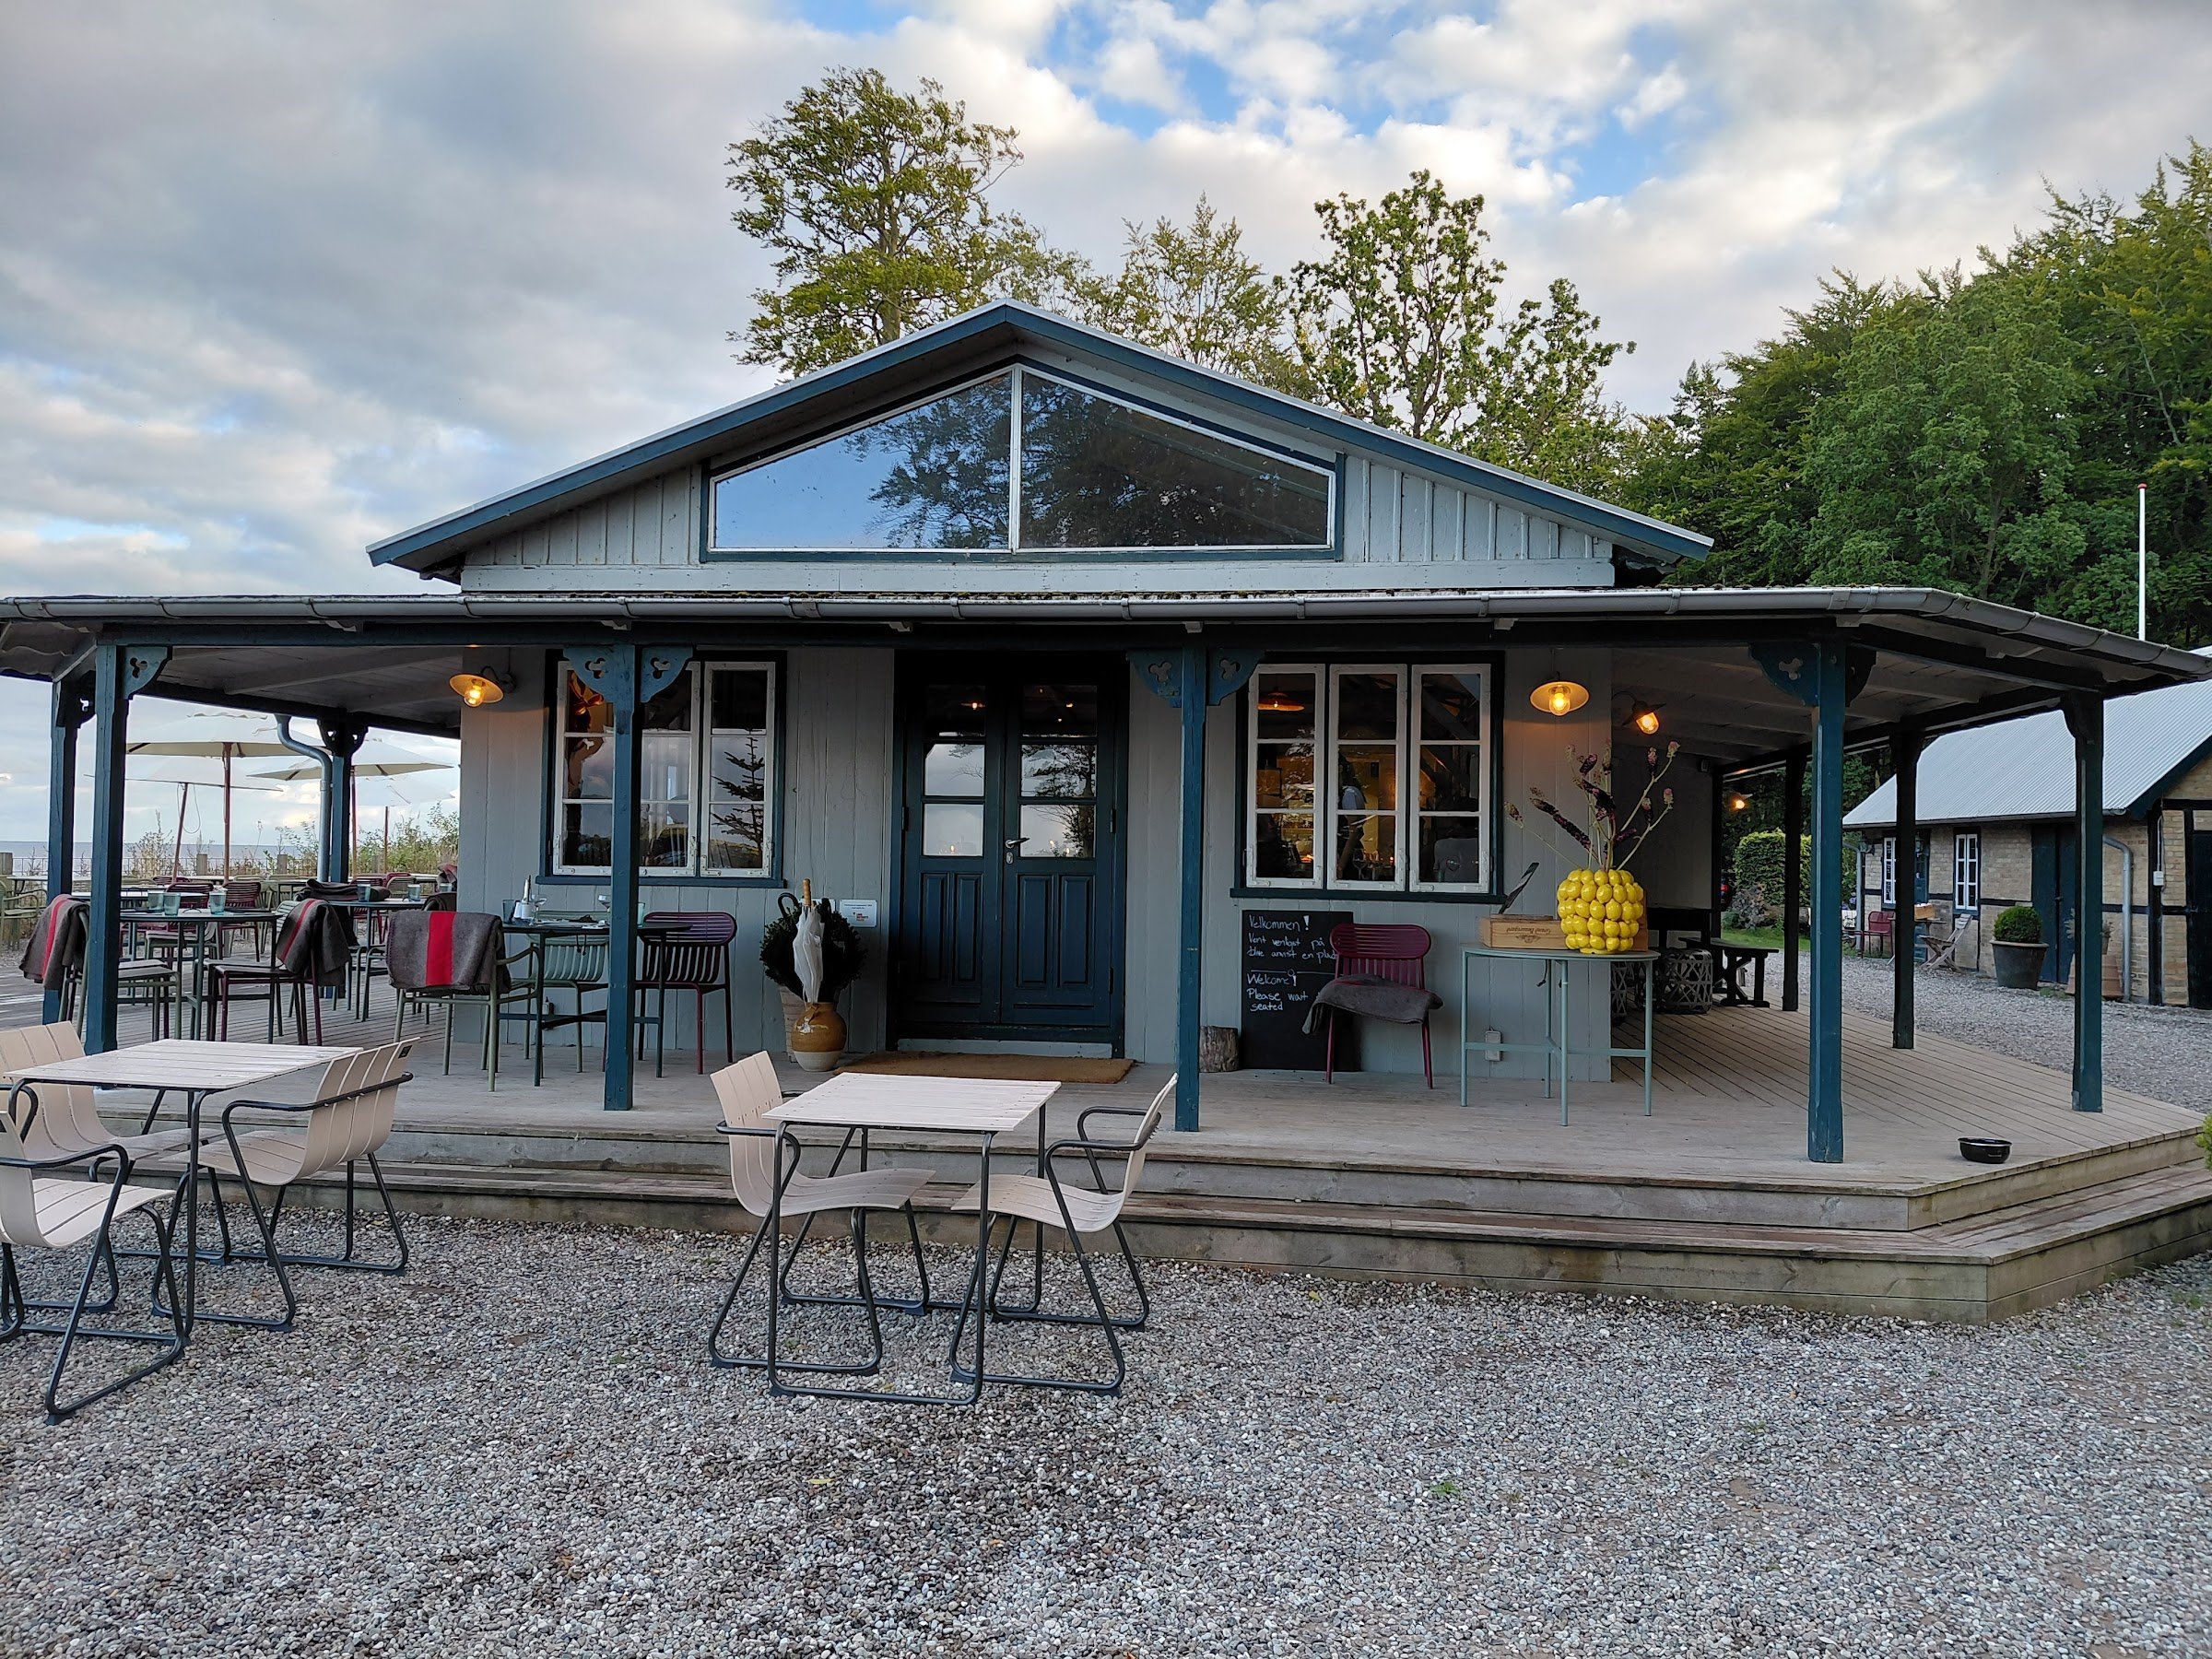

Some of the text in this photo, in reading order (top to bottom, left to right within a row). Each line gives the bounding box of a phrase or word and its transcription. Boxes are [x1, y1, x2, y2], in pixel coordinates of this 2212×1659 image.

[1249, 932, 1267, 944] Vent
[1311, 936, 1325, 950] på
[1316, 948, 1338, 964] plad
[1246, 987, 1282, 1002] Please
[1288, 990, 1309, 1002] wait
[1250, 1001, 1284, 1012] seated
